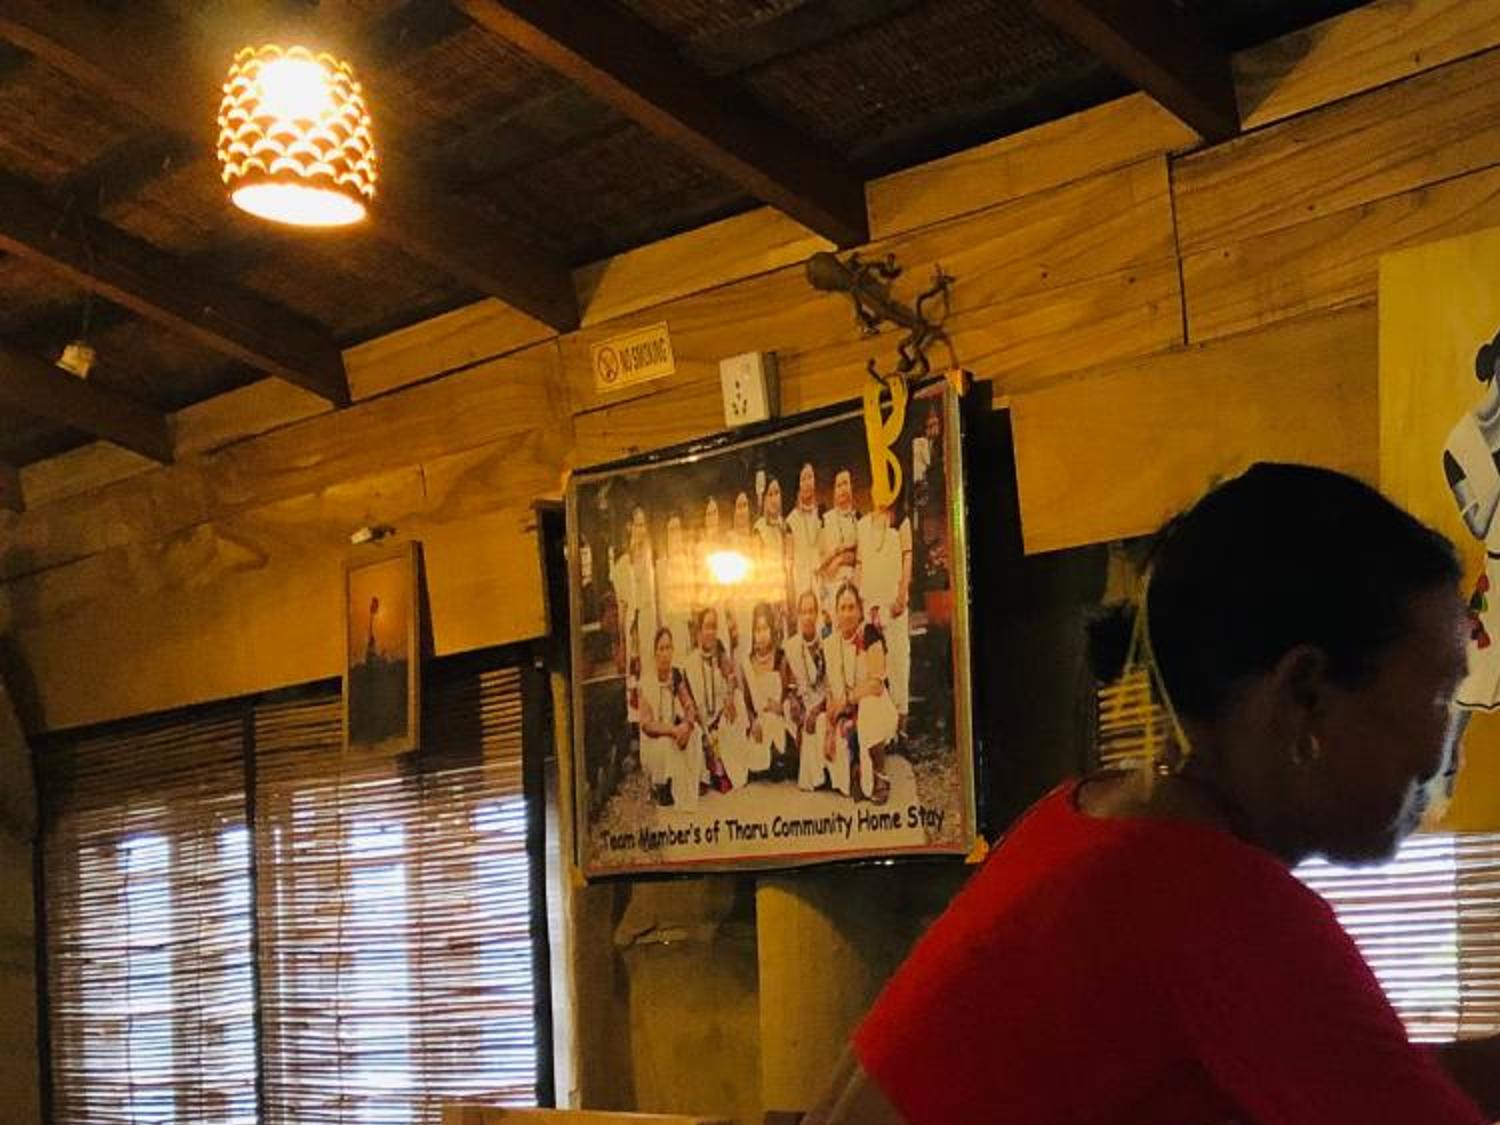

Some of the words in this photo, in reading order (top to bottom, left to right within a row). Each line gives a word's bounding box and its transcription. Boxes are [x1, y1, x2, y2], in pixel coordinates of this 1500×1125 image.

[619, 346, 632, 372] NO
[632, 336, 668, 370] SMOKING
[601, 831, 635, 850] Team
[638, 823, 701, 852] Member's
[705, 820, 721, 843] of
[725, 818, 769, 840] Tharu
[772, 810, 853, 839] Community
[858, 807, 902, 832] Home
[907, 805, 944, 832] Stay
